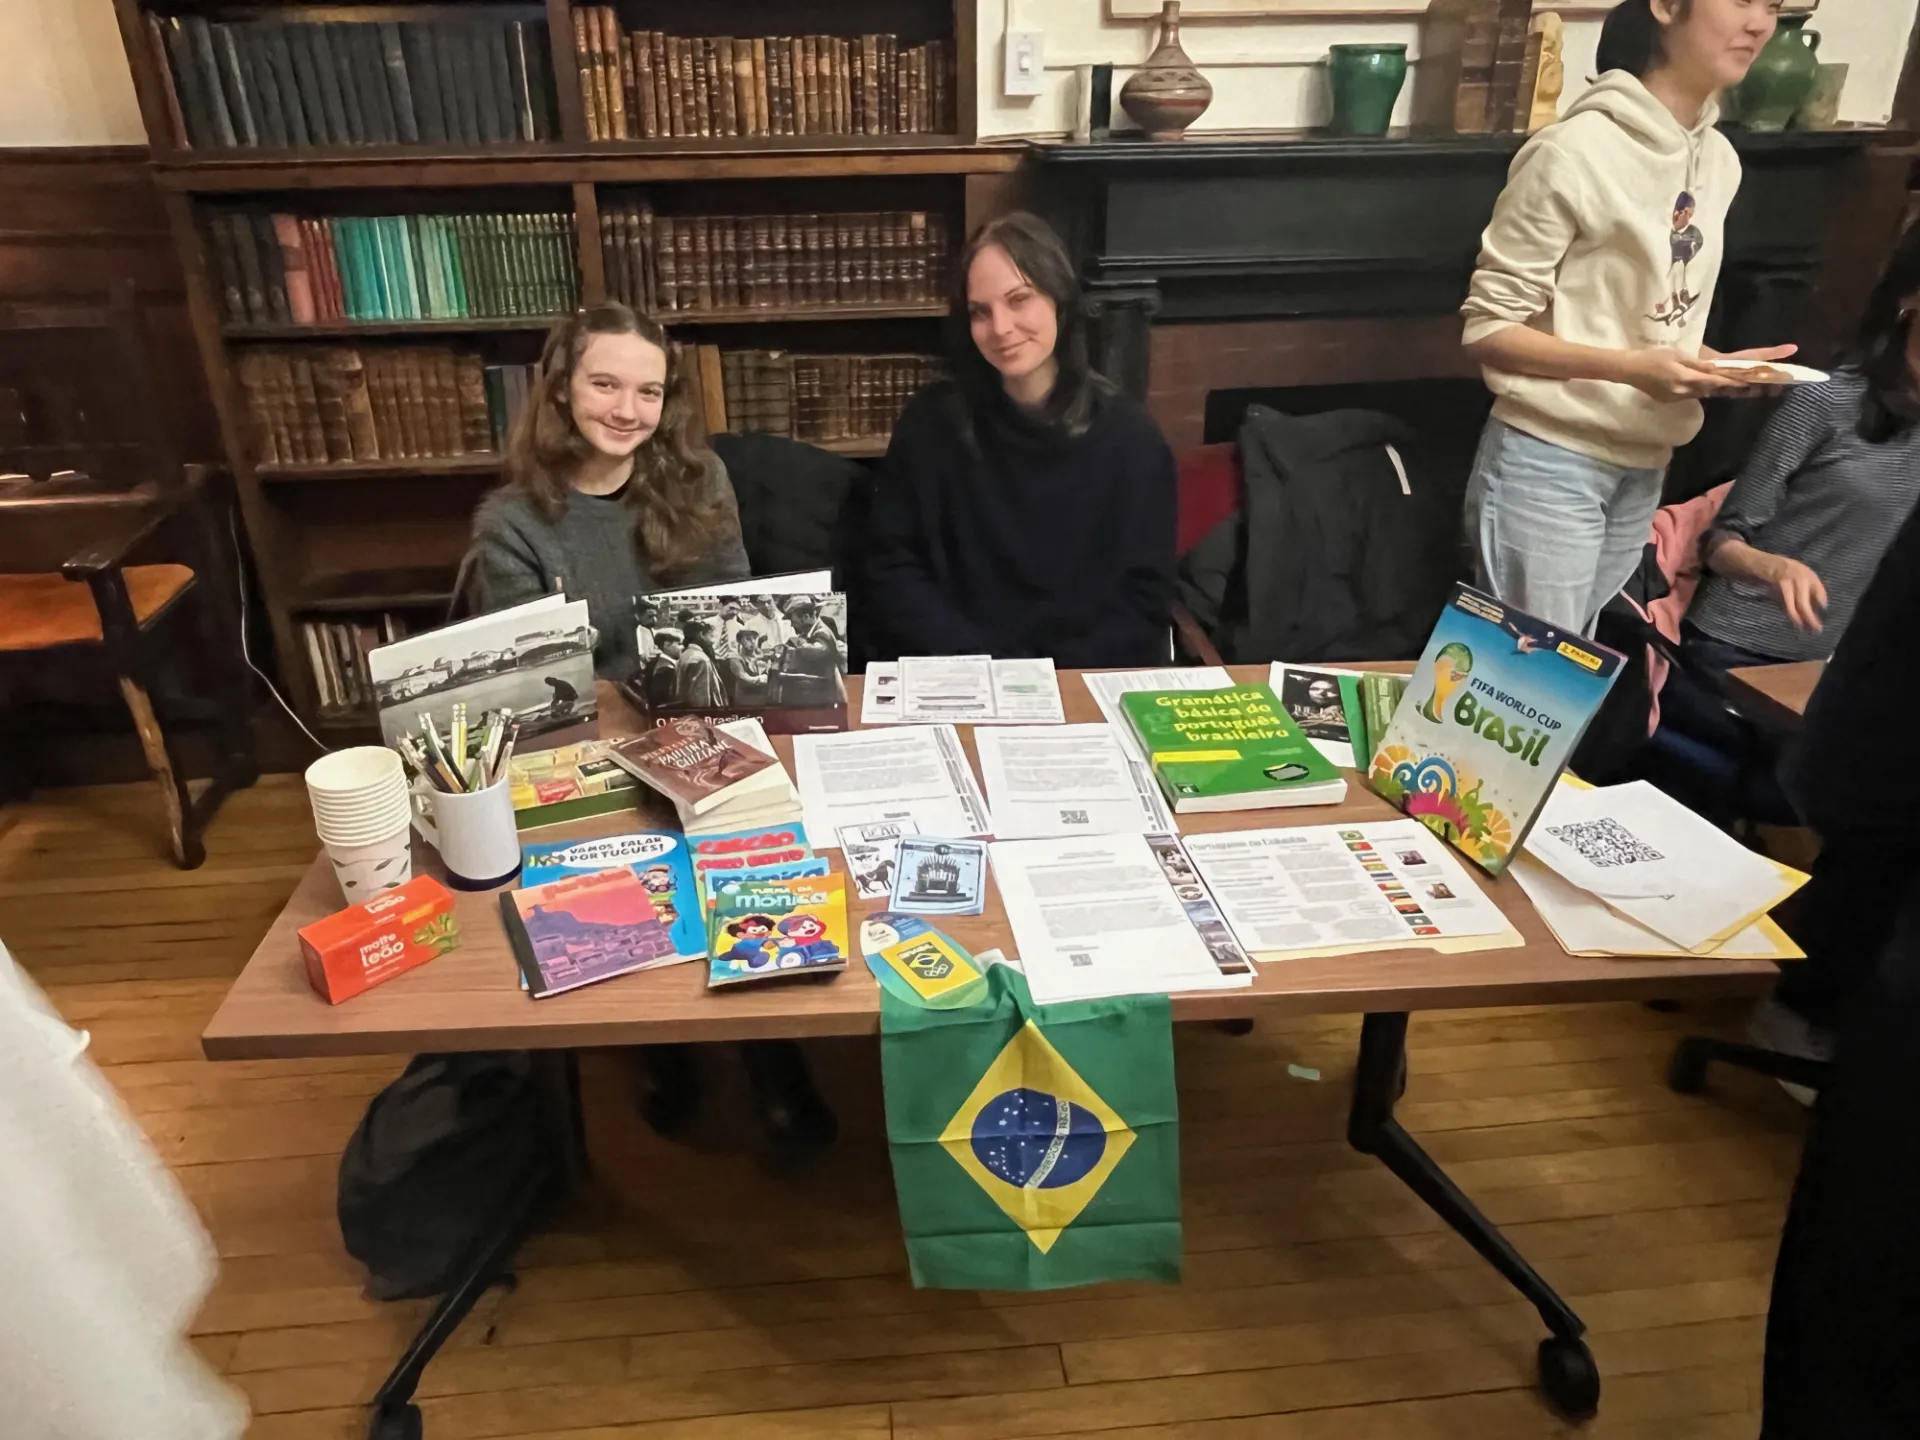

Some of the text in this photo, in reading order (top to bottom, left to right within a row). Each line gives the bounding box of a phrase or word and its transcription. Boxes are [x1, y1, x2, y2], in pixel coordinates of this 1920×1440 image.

[1155, 690, 1264, 706] Gramática
[1470, 678, 1562, 732] FIFA WORLD CUP
[1176, 703, 1272, 718] básica do
[705, 714, 764, 727] Brasilo
[1174, 715, 1281, 732] português
[1185, 728, 1290, 742] brasileiro
[570, 836, 663, 854] VAMOS FALAR
[750, 886, 791, 894] TURMA
